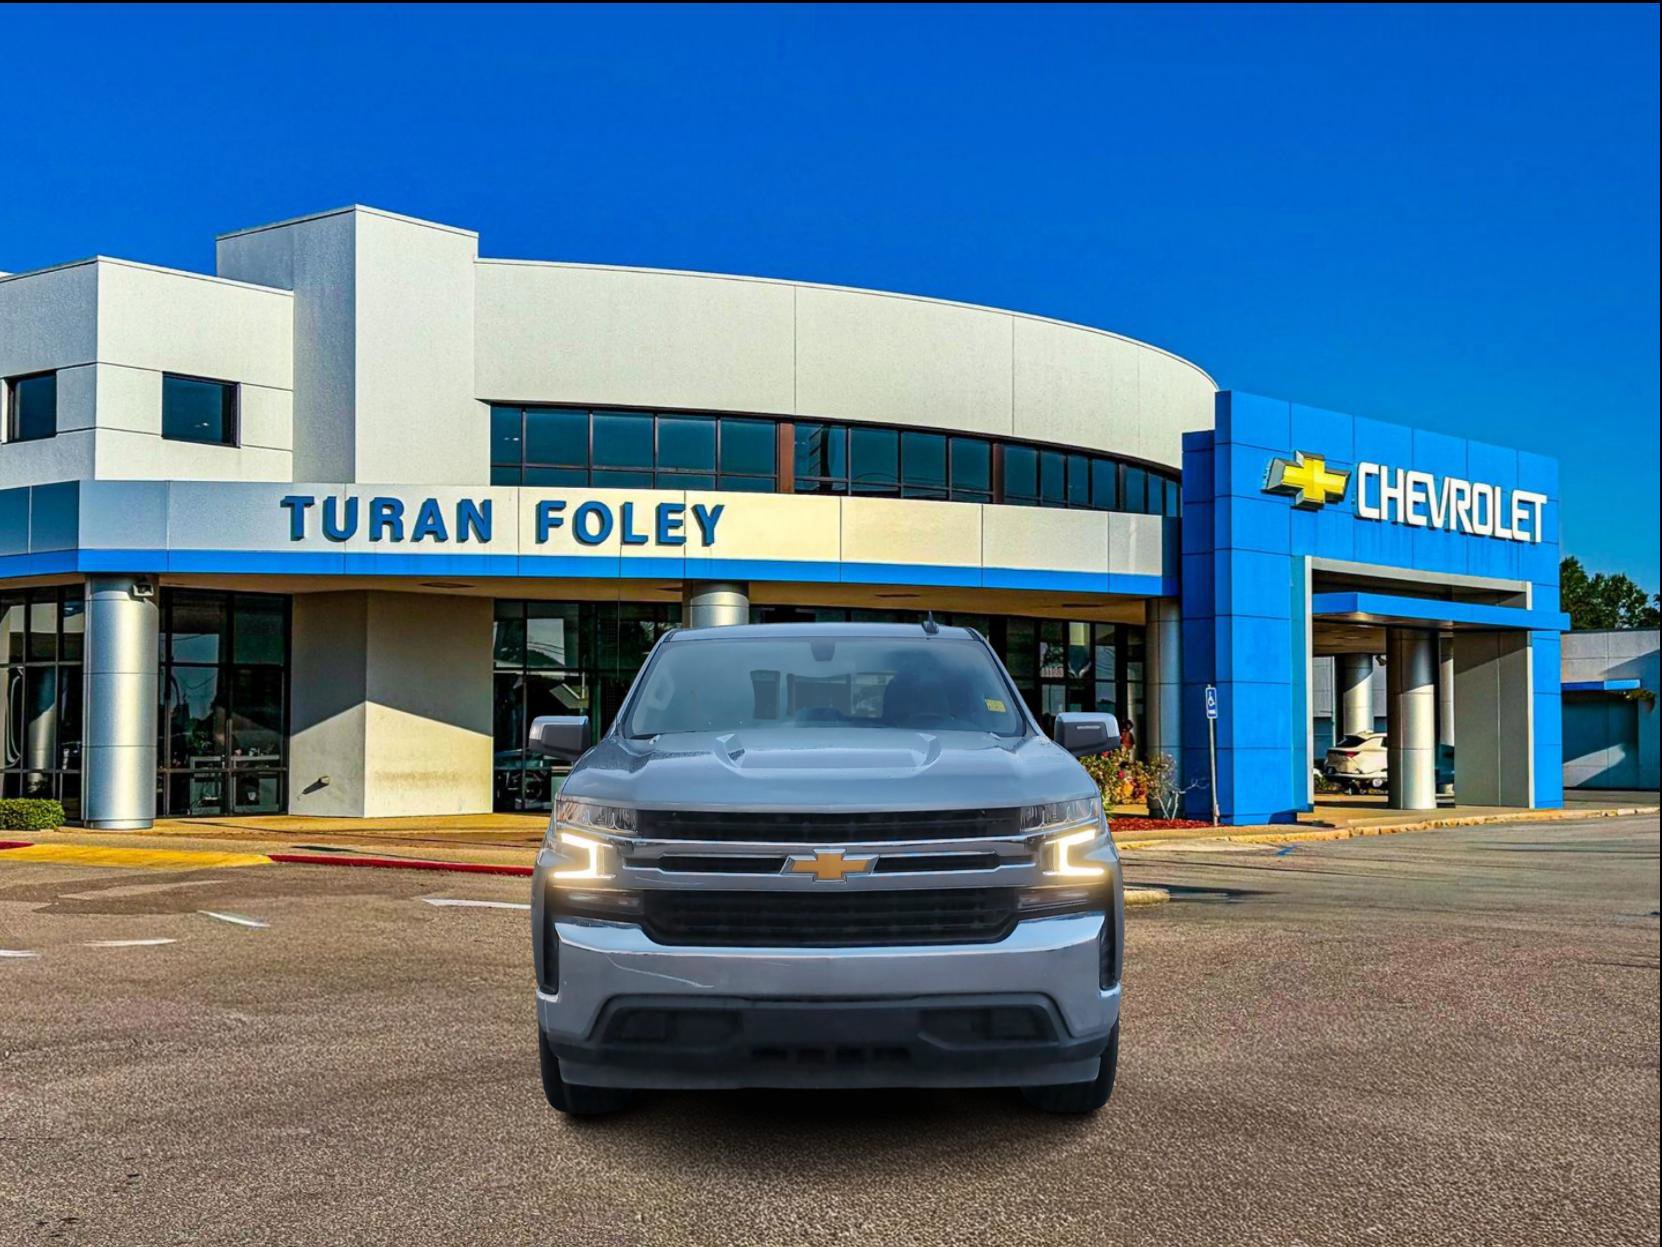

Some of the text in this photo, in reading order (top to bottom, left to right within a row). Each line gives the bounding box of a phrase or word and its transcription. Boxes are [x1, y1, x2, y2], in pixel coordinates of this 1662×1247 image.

[280, 496, 725, 547] TURAN FOLEY
[1357, 461, 1548, 543] CHEVROLET
